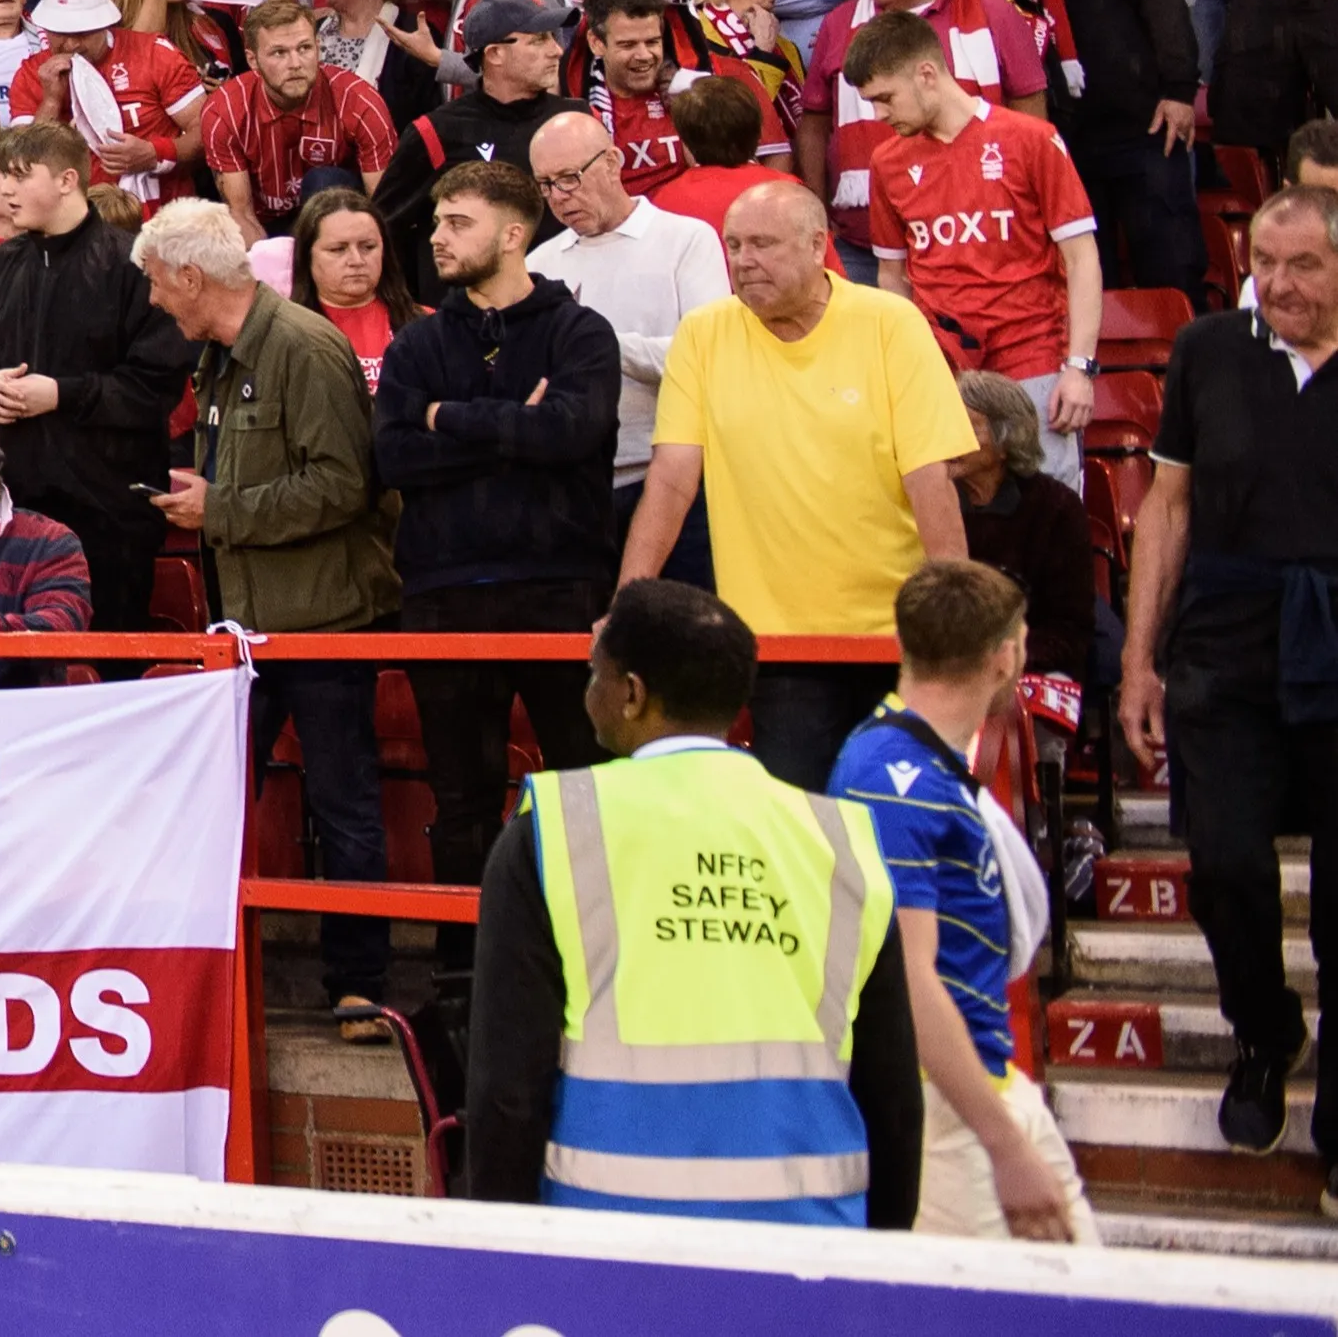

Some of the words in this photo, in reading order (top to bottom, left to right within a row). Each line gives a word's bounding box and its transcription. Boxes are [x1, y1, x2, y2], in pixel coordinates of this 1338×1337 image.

[912, 209, 1015, 251] BOXT
[671, 884, 789, 920] SAFEY
[655, 917, 799, 956] STEWAD
